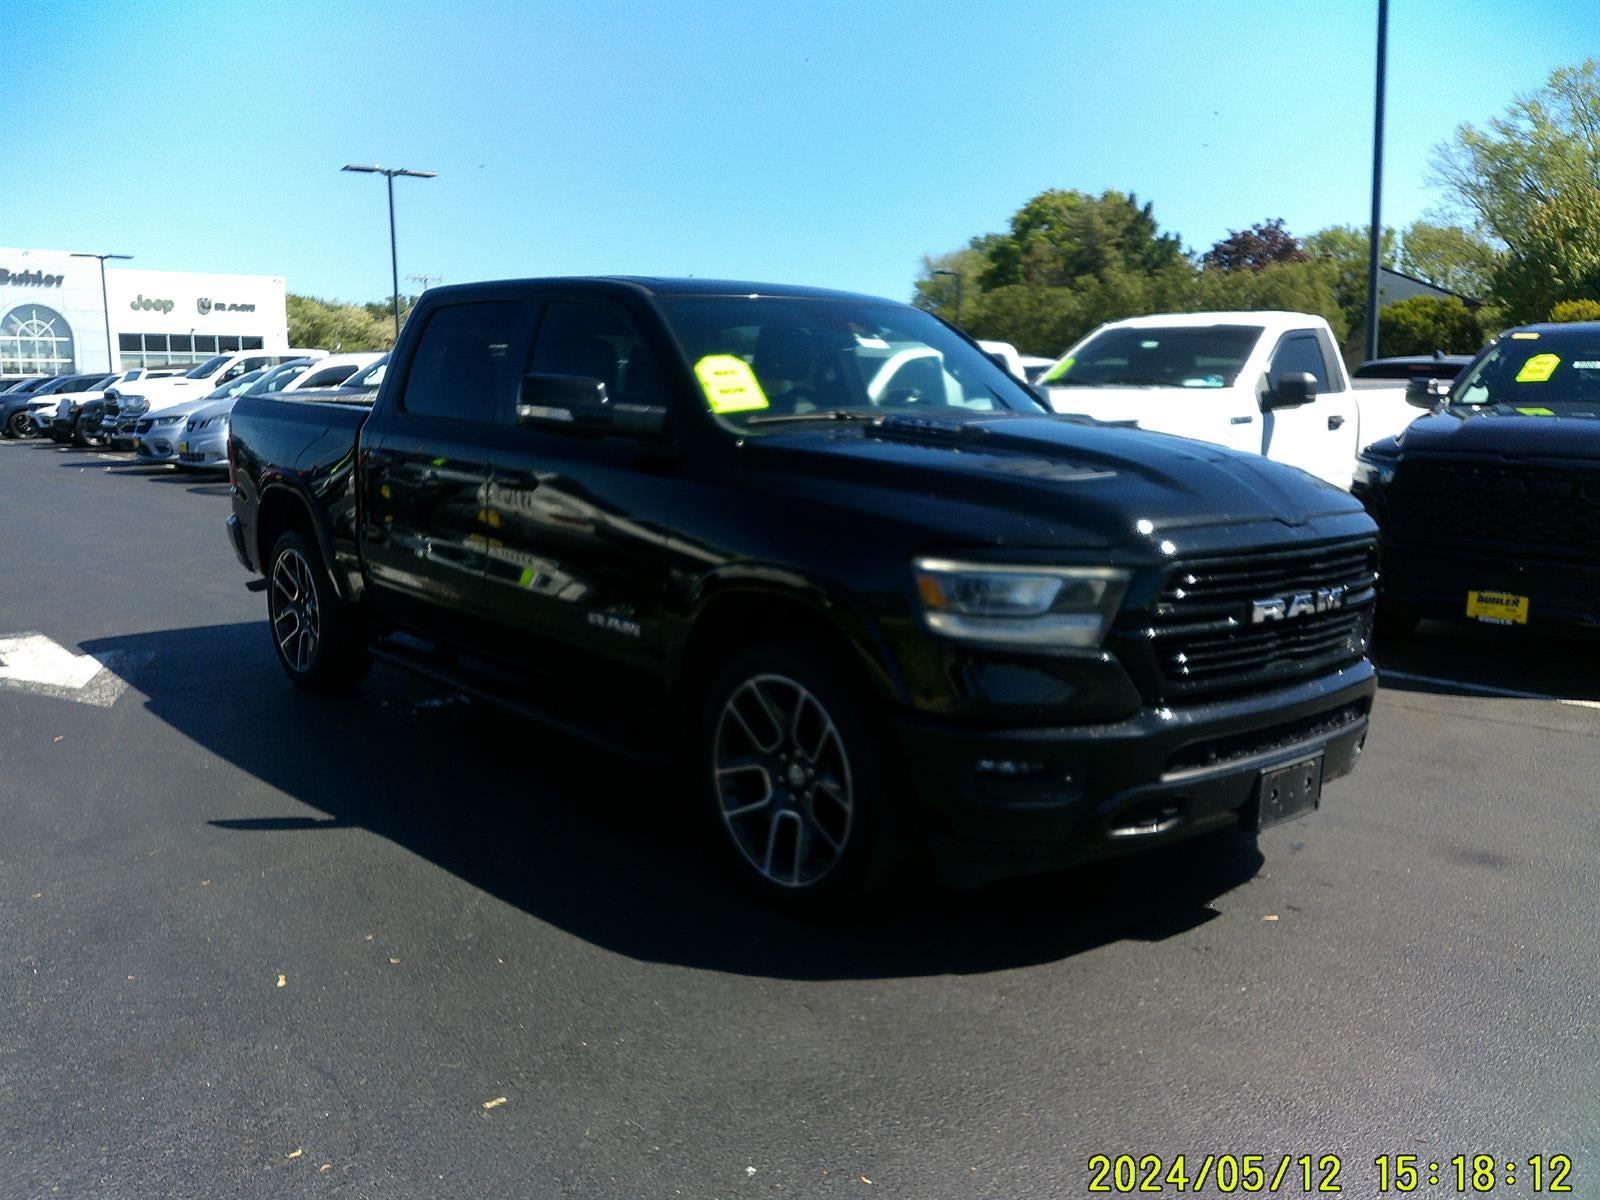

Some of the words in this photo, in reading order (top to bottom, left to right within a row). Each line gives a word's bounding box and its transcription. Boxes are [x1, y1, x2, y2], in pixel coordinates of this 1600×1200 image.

[0, 268, 64, 288] Buhler
[130, 295, 174, 314] Jeep
[214, 302, 256, 313] RAM
[1252, 586, 1343, 623] RAM
[588, 612, 641, 636] RAM
